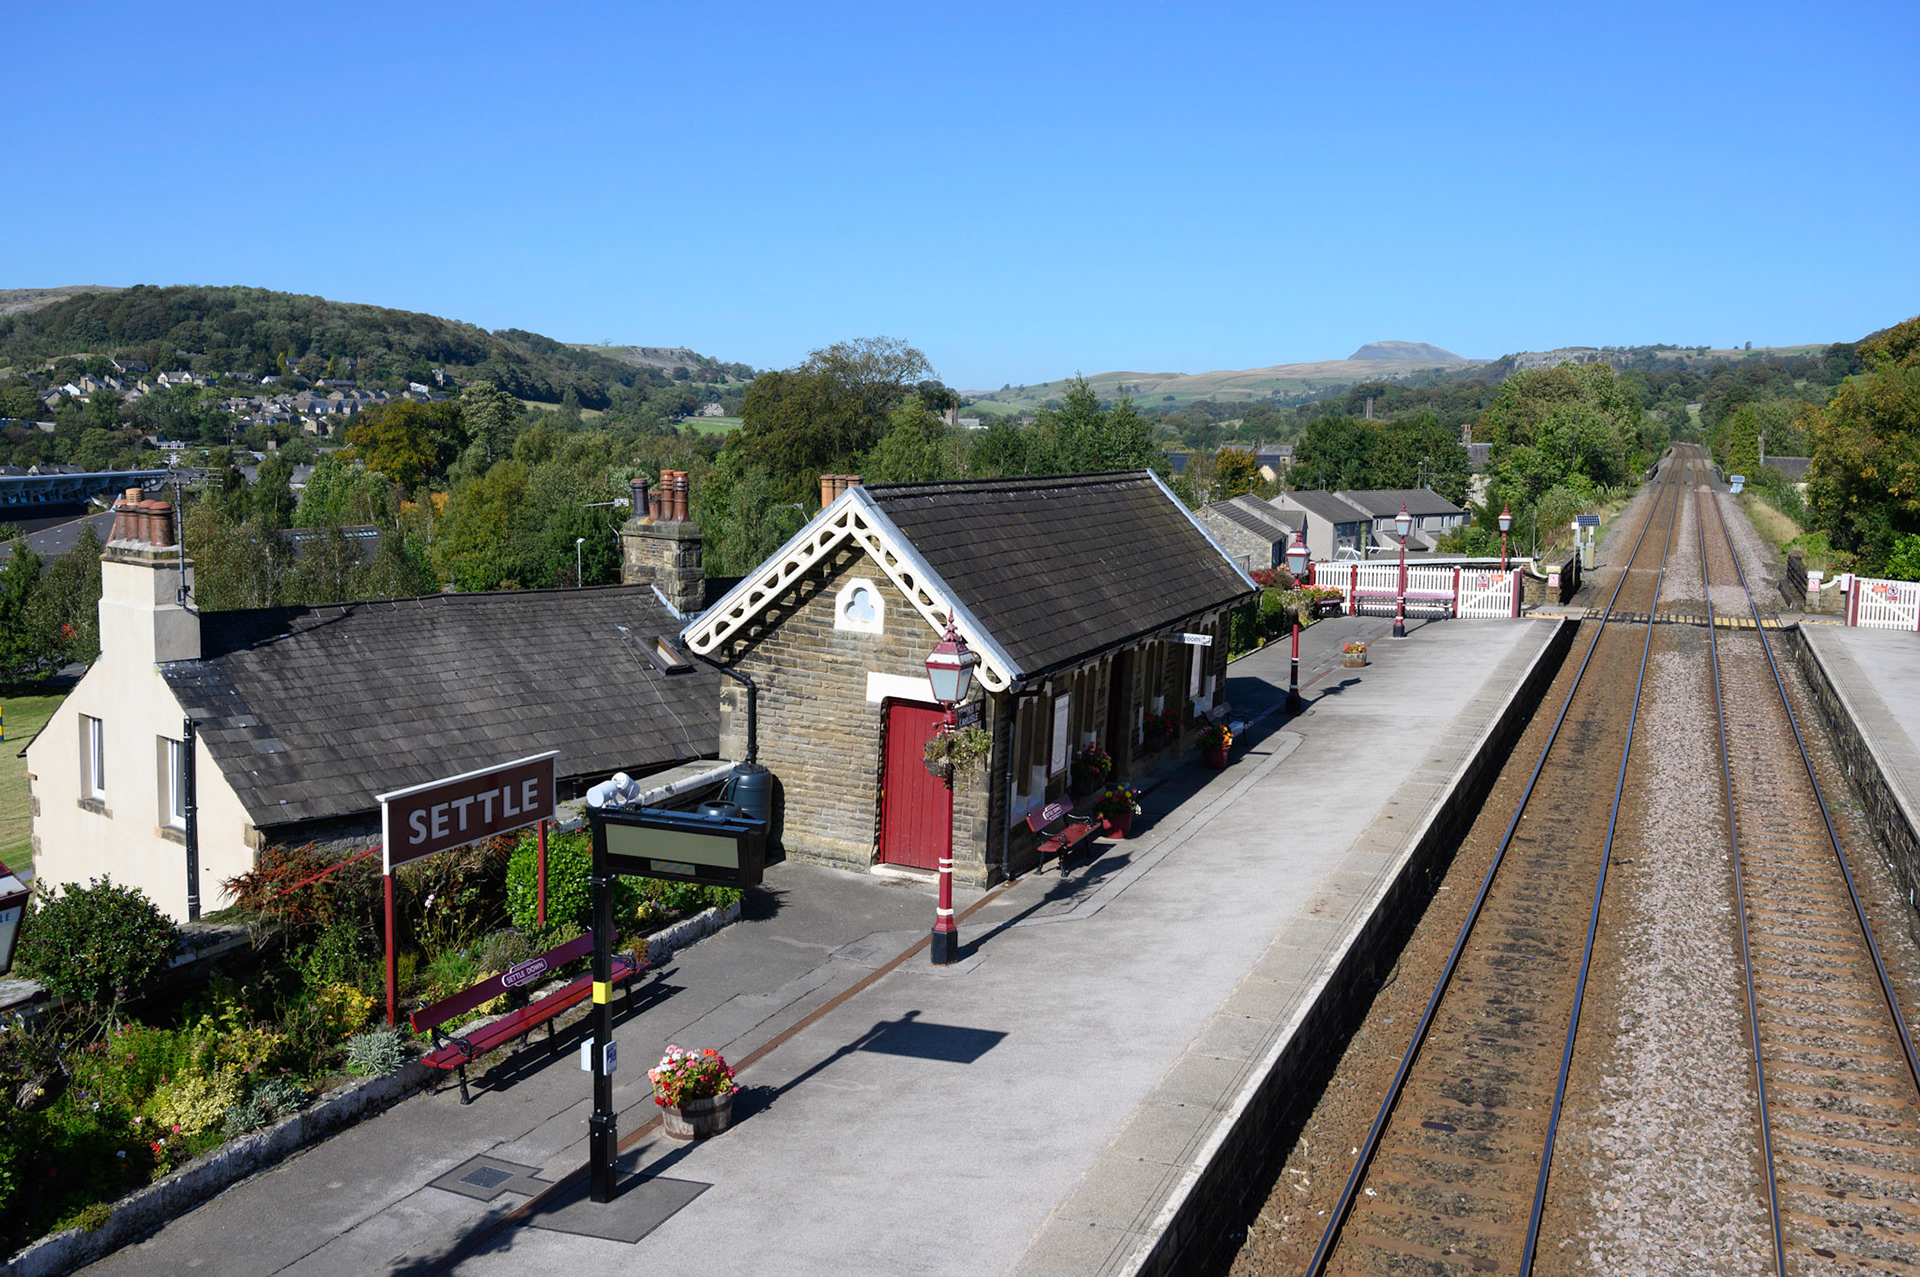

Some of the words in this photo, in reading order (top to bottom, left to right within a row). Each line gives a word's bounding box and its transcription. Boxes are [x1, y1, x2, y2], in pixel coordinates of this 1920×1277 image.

[408, 777, 539, 845] SETTLE
[506, 969, 526, 984] SETTLE
[526, 961, 544, 974] DOWN
